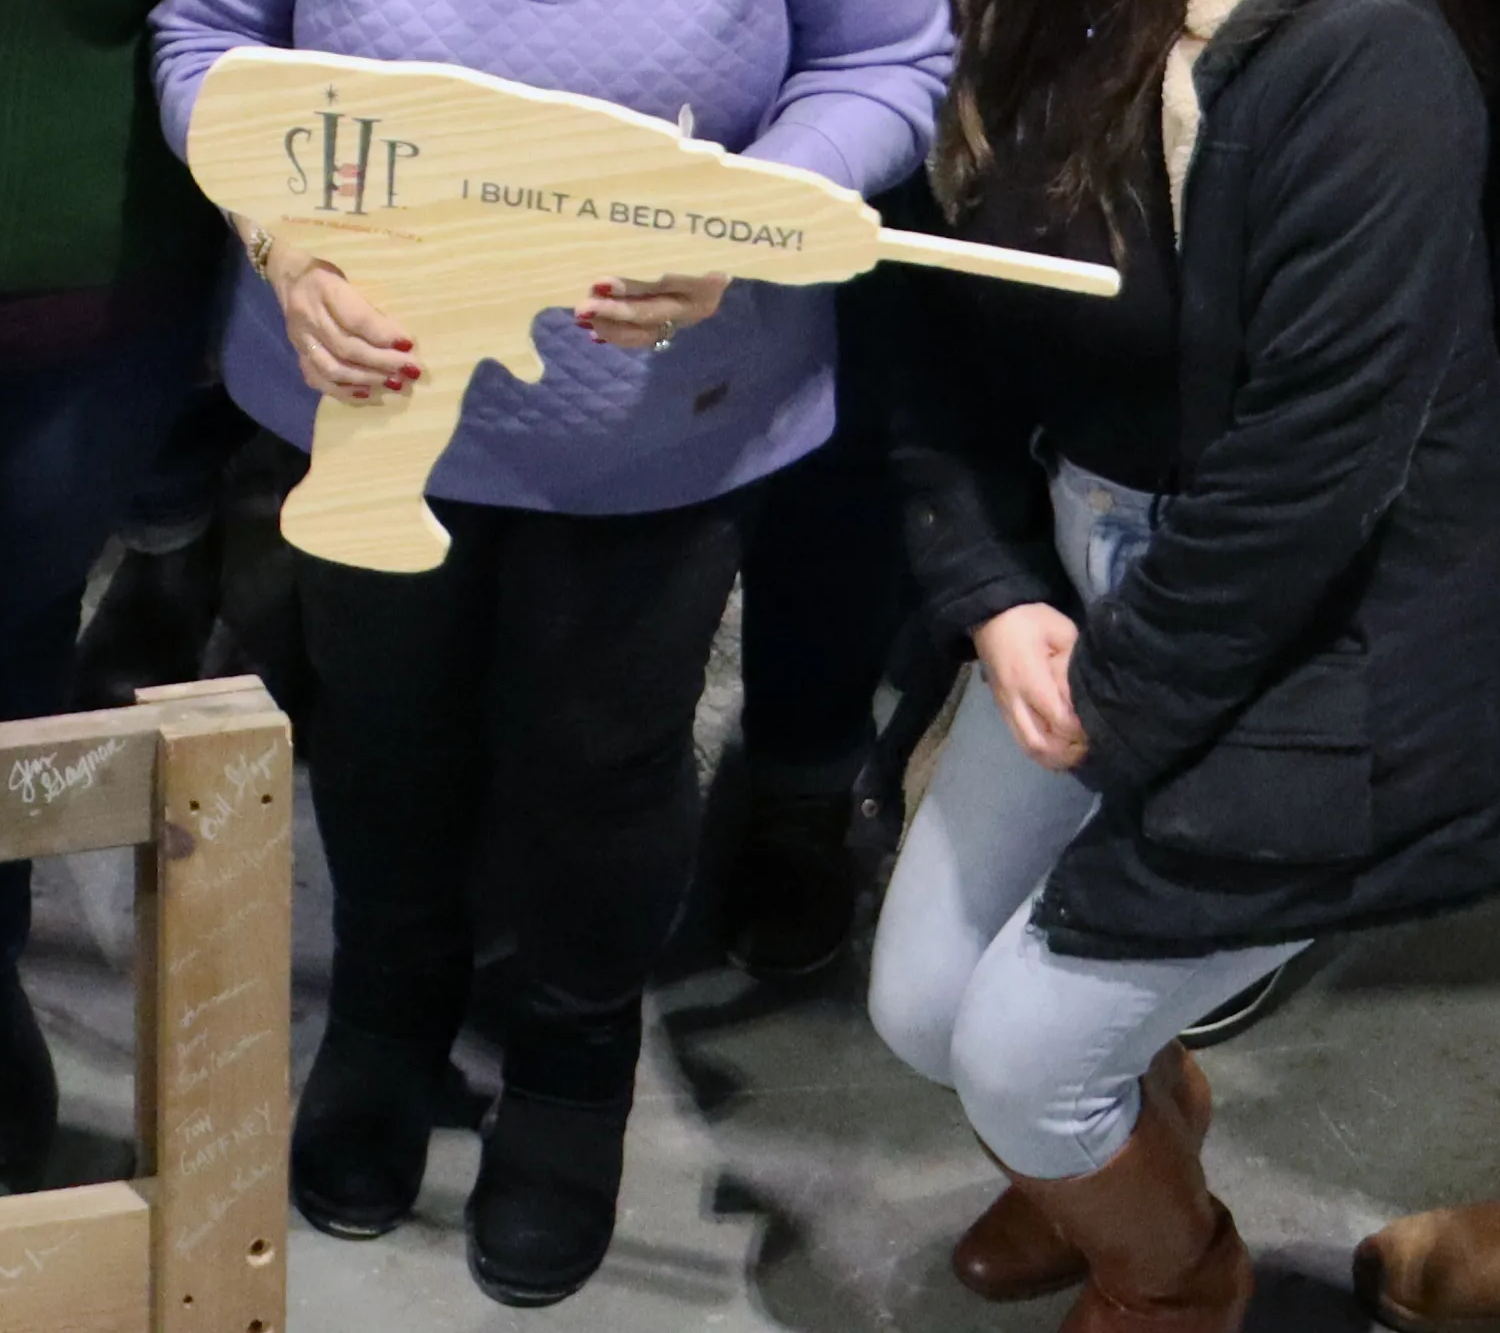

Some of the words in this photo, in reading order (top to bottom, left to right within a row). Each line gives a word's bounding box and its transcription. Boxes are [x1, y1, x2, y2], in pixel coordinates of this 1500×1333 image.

[283, 110, 420, 216] SHP
[461, 179, 470, 200] I
[480, 182, 570, 215] BUILT
[577, 199, 600, 220] A
[609, 202, 676, 231] BED
[686, 213, 805, 253] TODAY!
